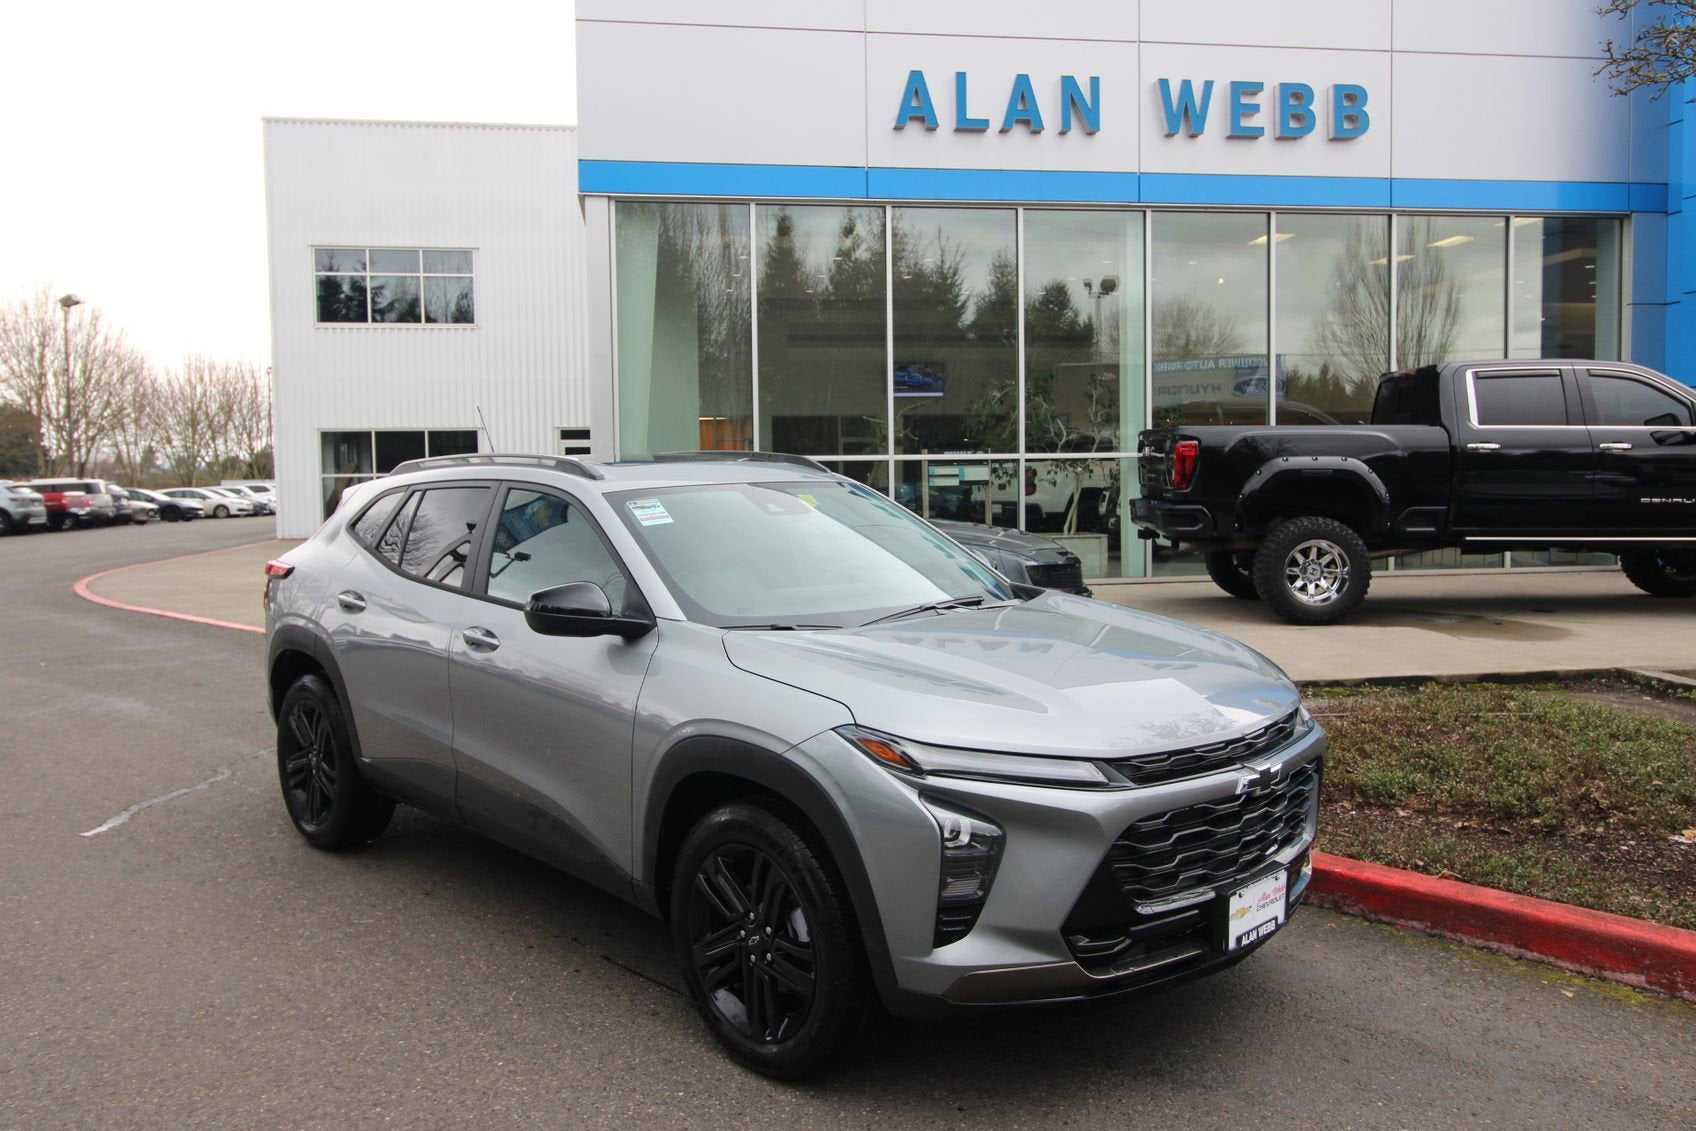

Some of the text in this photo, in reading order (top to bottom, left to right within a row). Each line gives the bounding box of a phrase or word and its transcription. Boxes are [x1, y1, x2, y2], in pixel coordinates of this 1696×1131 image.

[893, 69, 1370, 140] ALAN WEBB
[1241, 919, 1276, 947] ALAN WEBB
